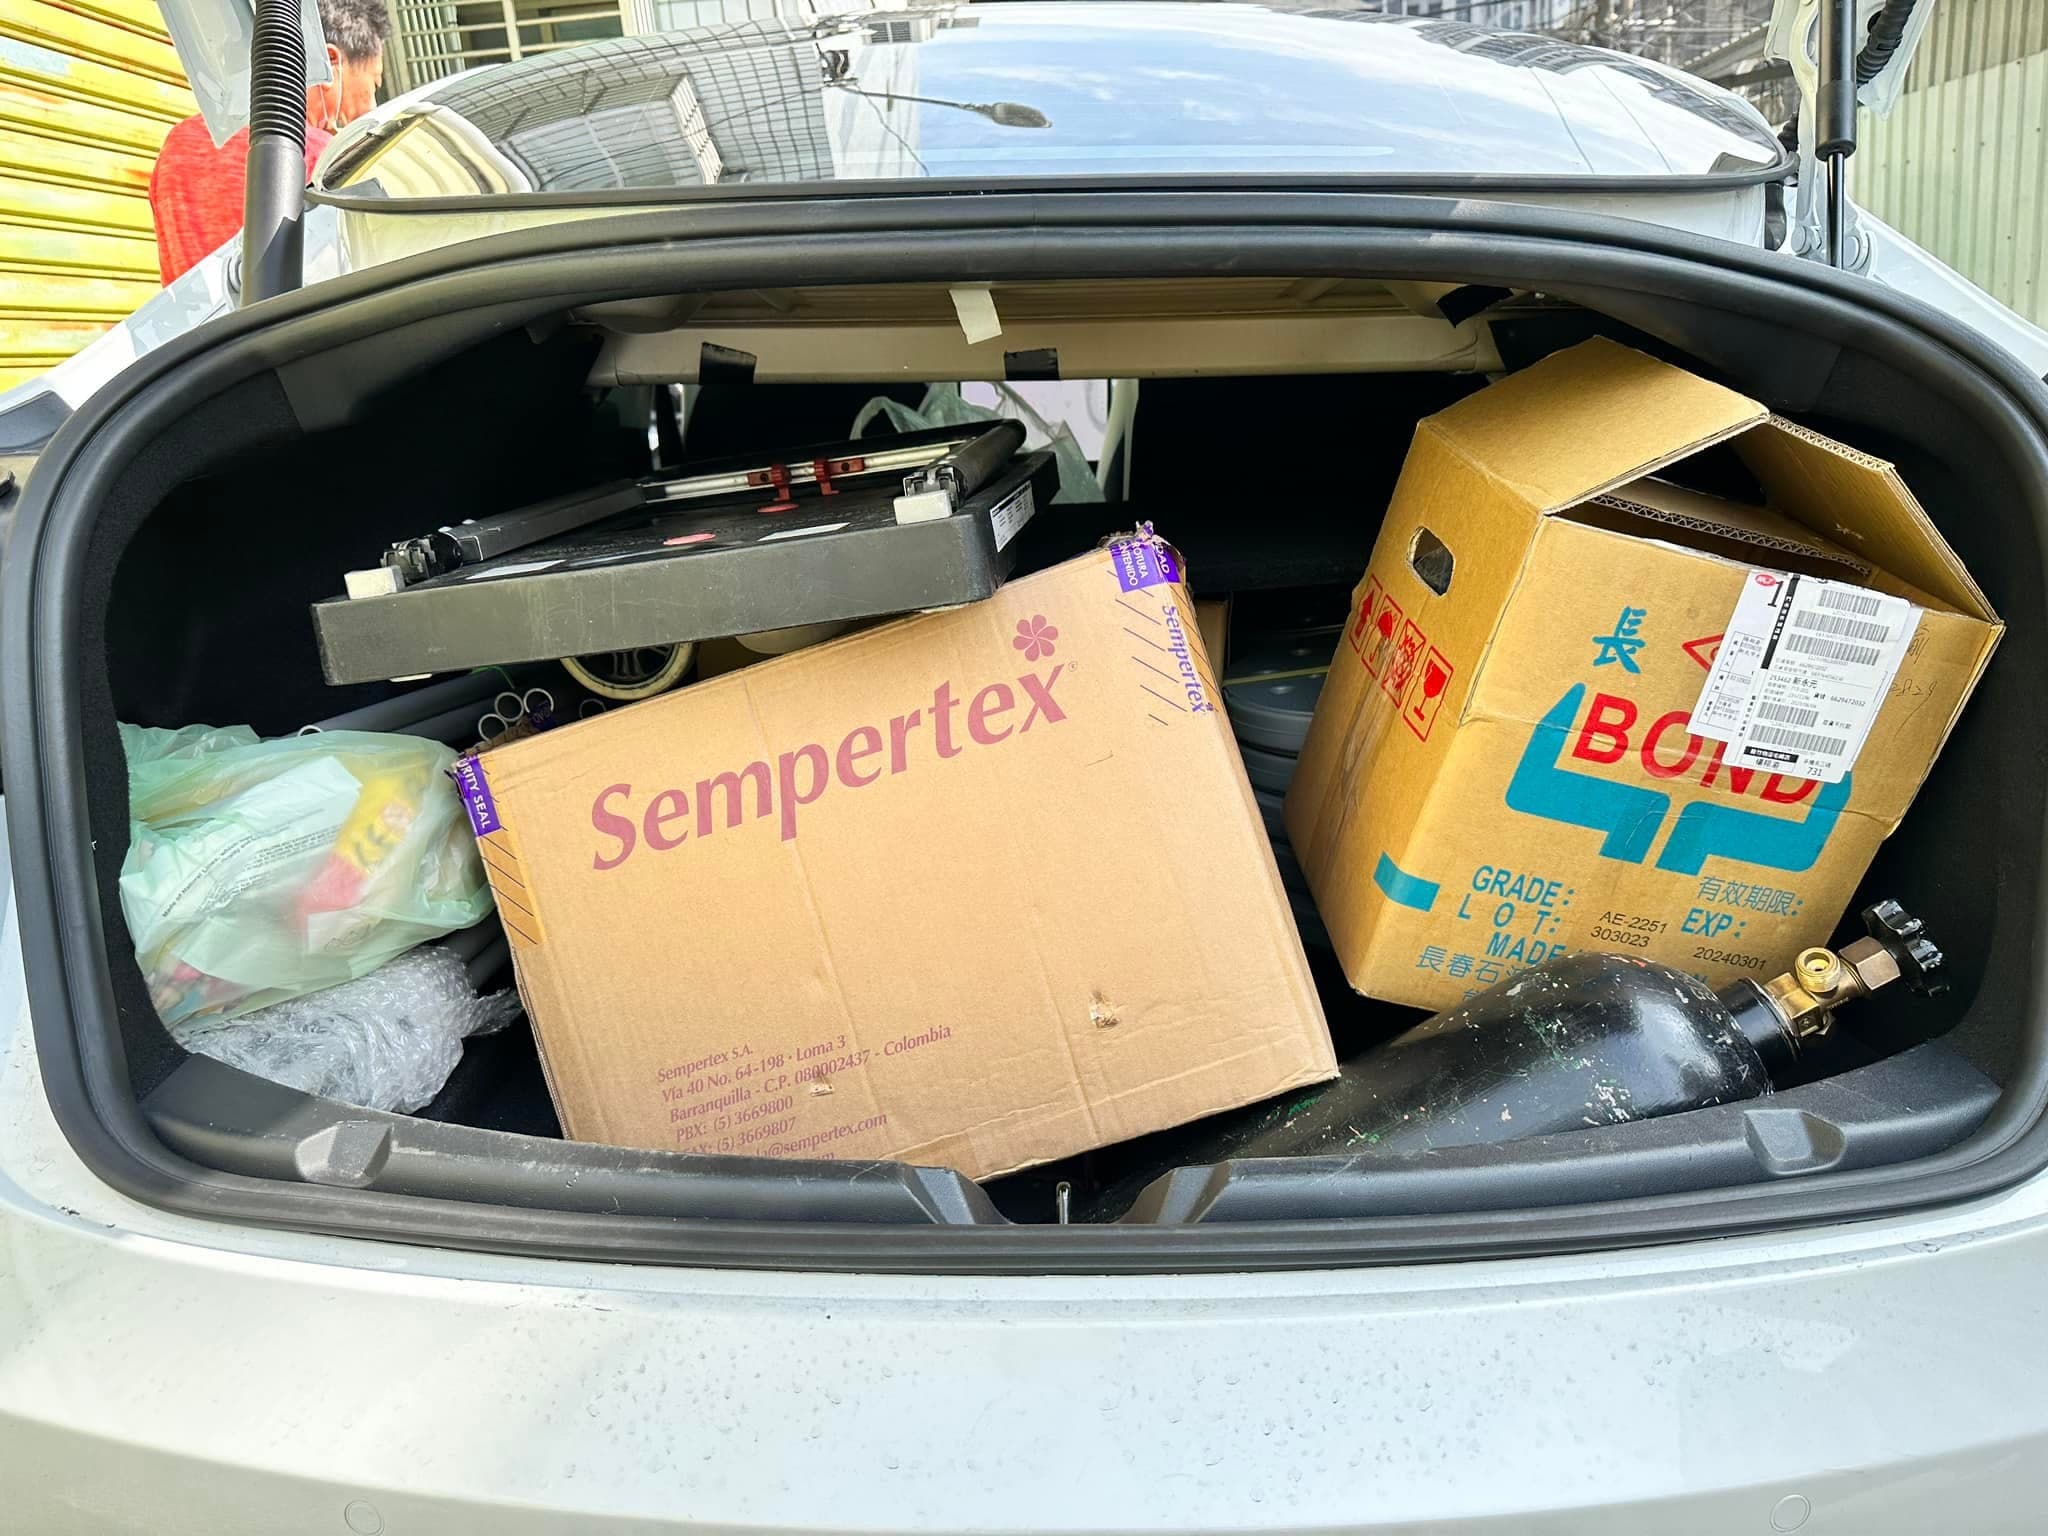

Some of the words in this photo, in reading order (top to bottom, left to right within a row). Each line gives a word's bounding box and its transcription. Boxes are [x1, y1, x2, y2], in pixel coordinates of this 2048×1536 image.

[1133, 542, 1149, 578] ROTURA
[1162, 605, 1206, 712] Sempertex
[1592, 606, 1648, 674] 長
[591, 664, 1068, 870] Sempertex
[473, 795, 491, 829] SEAL
[1471, 864, 1575, 908] GRADE:
[1697, 876, 1804, 917] 有效期限:
[1591, 926, 1650, 948] 303023
[1599, 911, 1668, 935] AE-2251
[1681, 908, 1747, 940] EXP:
[1692, 945, 1768, 972] 20240301
[657, 1050, 729, 1084] Sempertex
[669, 1087, 752, 1123] Barranquilla
[763, 1074, 792, 1093] C.P.
[794, 1049, 871, 1085] 080002437
[884, 1024, 951, 1057] Colombia
[686, 1078, 705, 1095] 40
[707, 1073, 732, 1089] No.
[735, 1054, 785, 1081] 64-198
[796, 1041, 833, 1062] Loma
[837, 1035, 847, 1049] 3
[676, 1124, 707, 1143] PBX:
[713, 1115, 732, 1133] (5)
[734, 1095, 794, 1125] 3669800
[716, 1135, 735, 1153] (5)
[737, 1116, 797, 1146] 3669807
